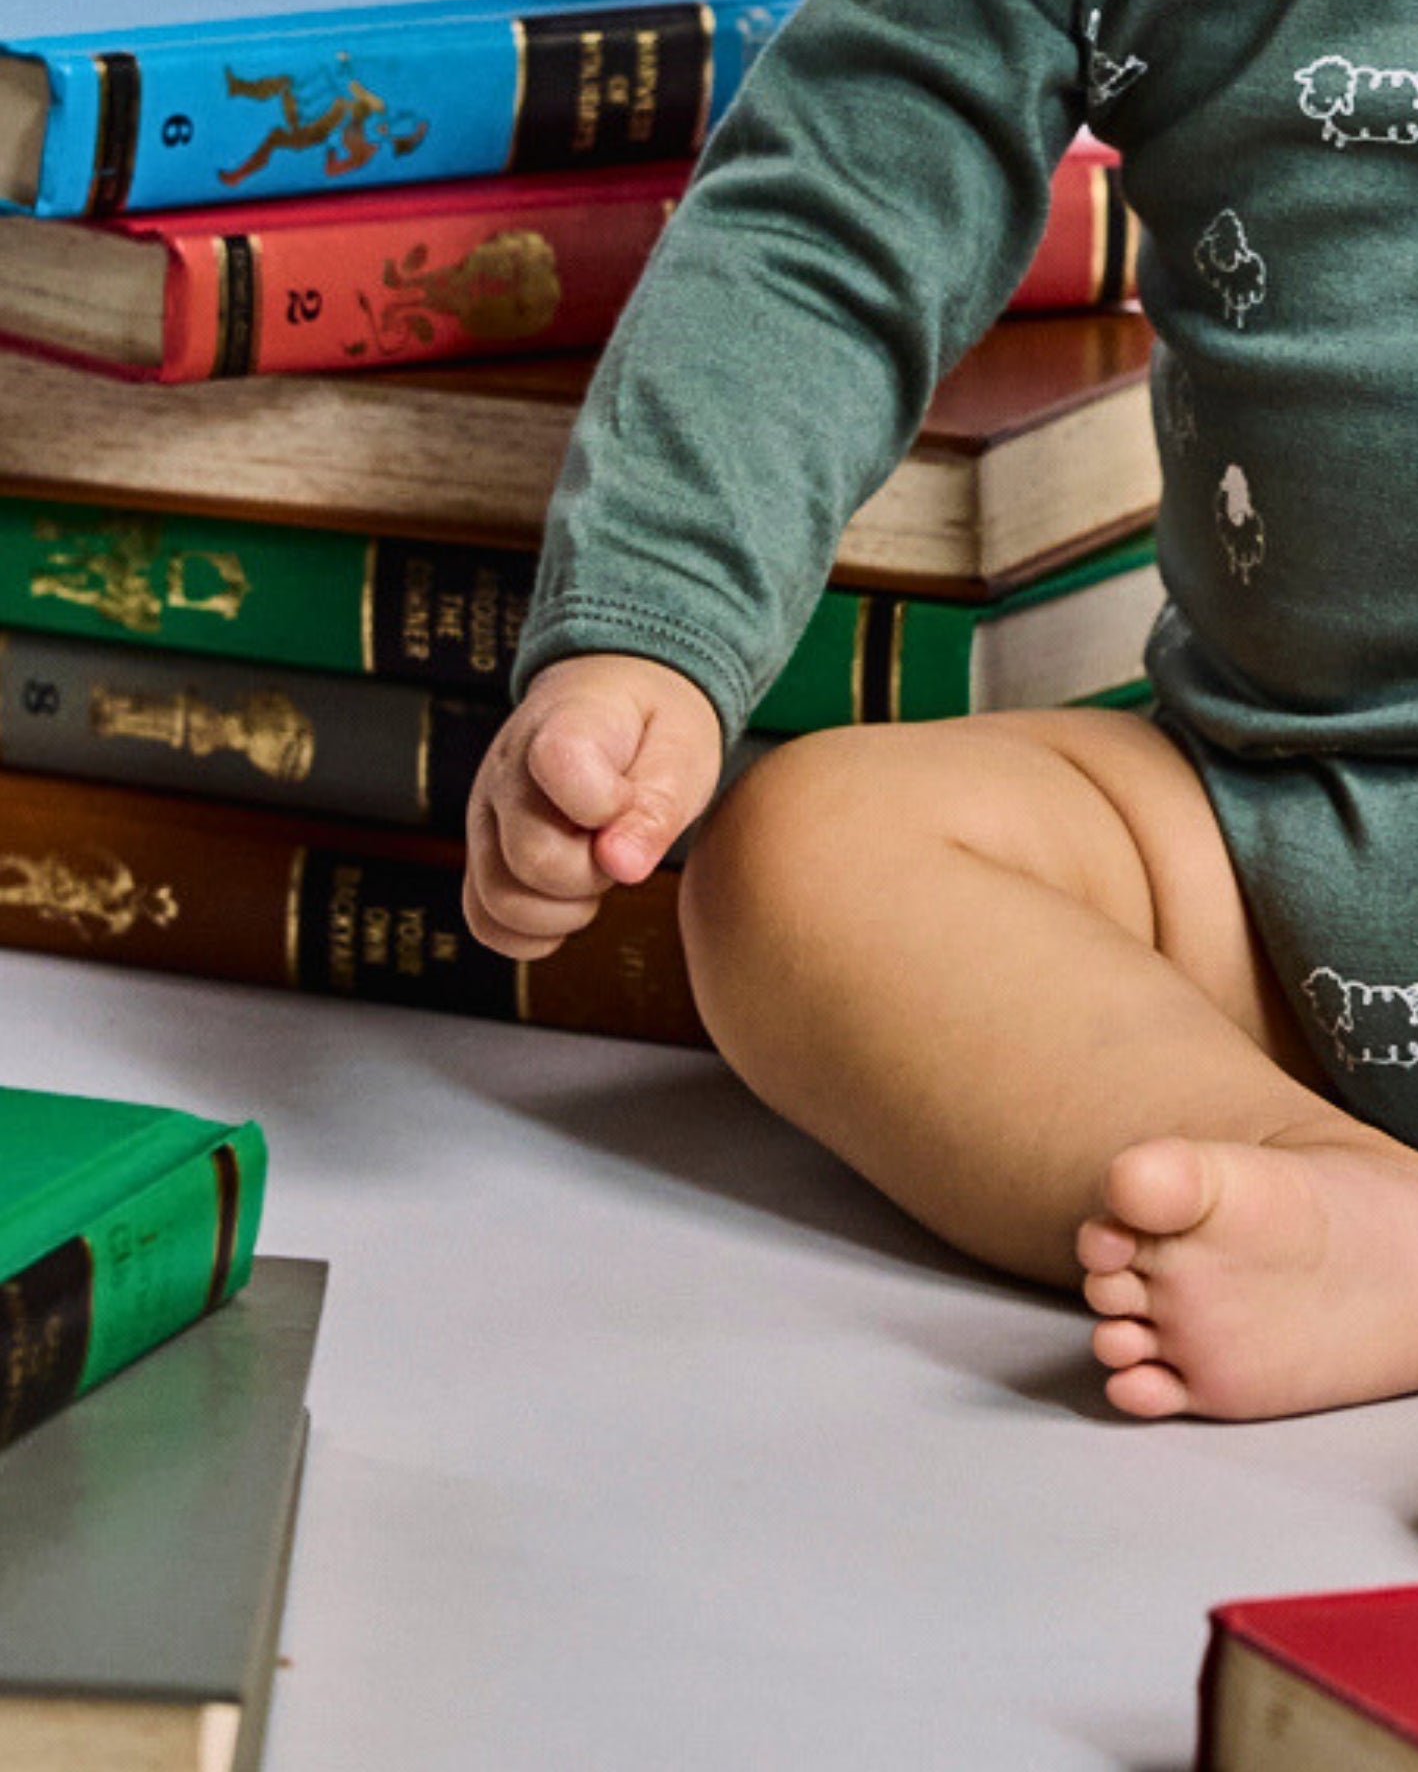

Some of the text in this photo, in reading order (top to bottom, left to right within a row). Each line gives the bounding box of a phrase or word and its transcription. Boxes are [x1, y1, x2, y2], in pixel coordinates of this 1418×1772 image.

[162, 114, 194, 149] 6
[286, 289, 323, 326] 2
[435, 593, 464, 641] THE
[23, 679, 60, 716] 8
[362, 907, 391, 966] OWN
